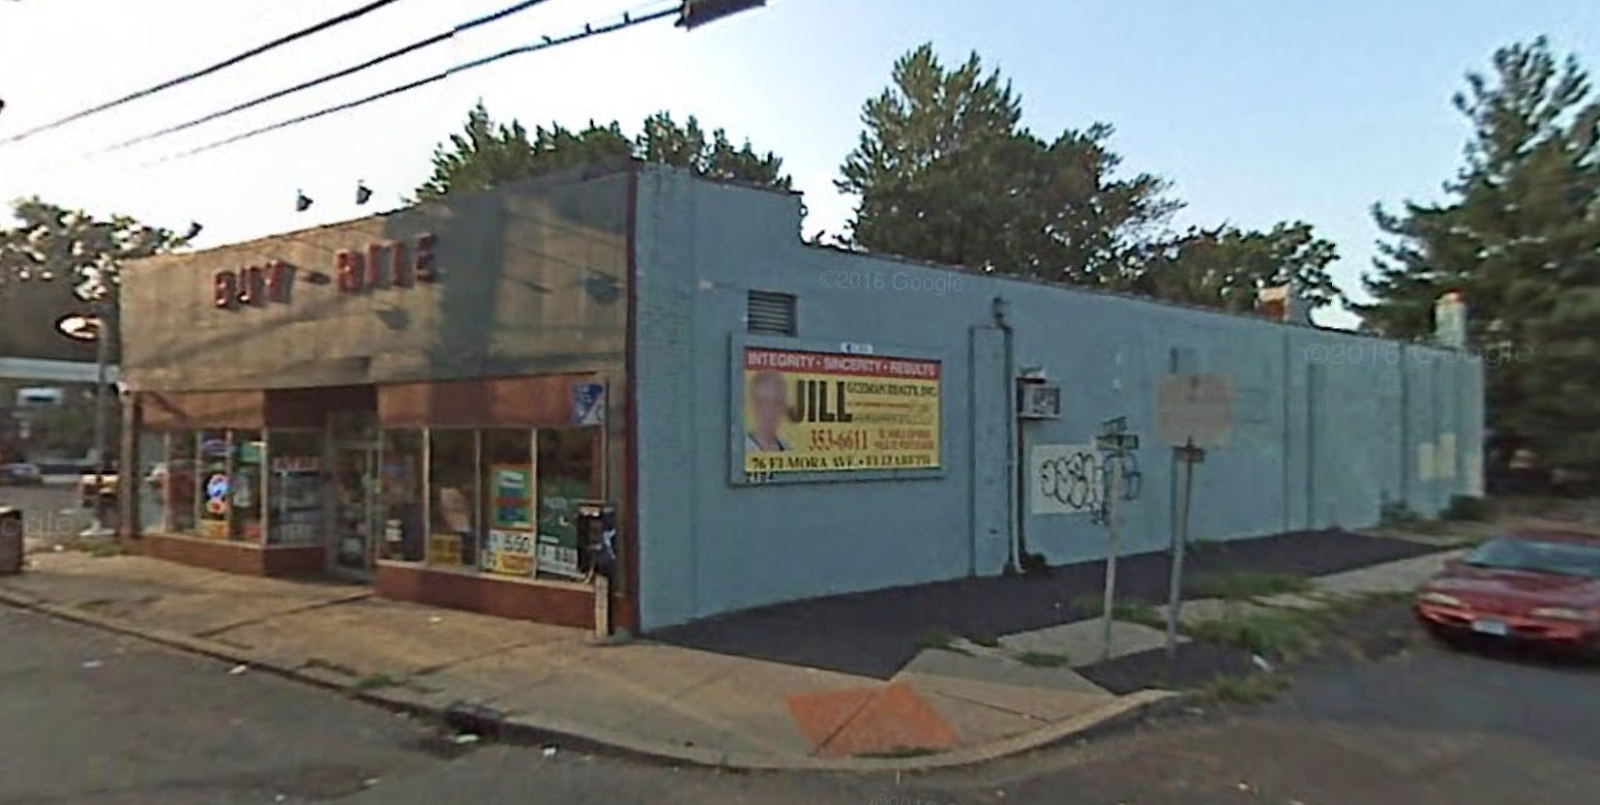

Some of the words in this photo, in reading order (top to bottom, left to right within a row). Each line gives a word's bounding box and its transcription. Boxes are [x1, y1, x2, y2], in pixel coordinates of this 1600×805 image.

[213, 257, 288, 308] BUY
[335, 233, 438, 293] RITE
[747, 352, 816, 369] INTEGRITY
[823, 356, 882, 373] SINCERITY
[889, 361, 937, 377] RESULTS
[788, 380, 853, 423] JILL
[809, 428, 868, 451] 353-6611
[865, 453, 932, 466] ELIZABETH
